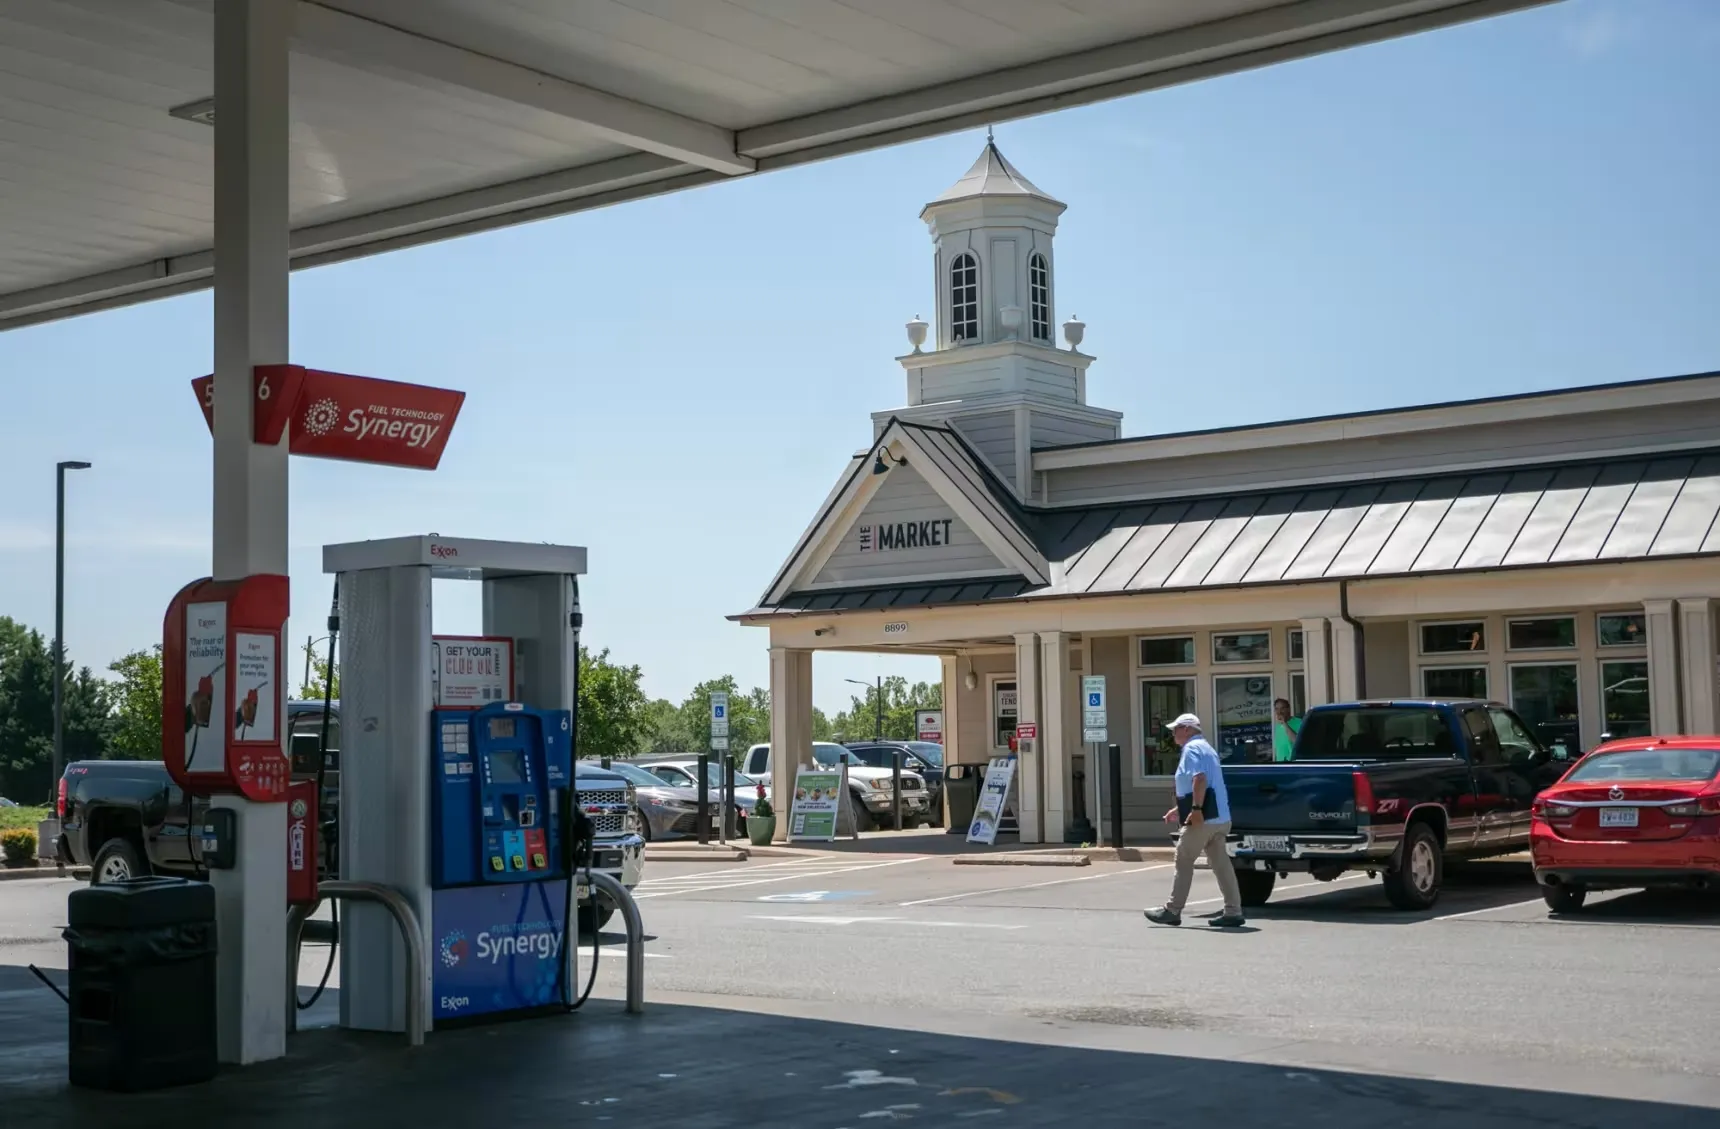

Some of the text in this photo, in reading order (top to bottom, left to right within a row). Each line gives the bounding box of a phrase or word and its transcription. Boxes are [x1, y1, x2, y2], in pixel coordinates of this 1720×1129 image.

[258, 376, 270, 400] 6
[368, 404, 444, 421] FUEL TECHNOLOGY
[344, 408, 440, 448] Synergy
[860, 526, 871, 551] THE
[879, 519, 952, 550] MARKET
[430, 544, 457, 559] Exxon
[884, 623, 907, 633] 8899
[189, 637, 202, 646] The
[216, 634, 224, 645] of
[189, 646, 224, 659] reliability
[446, 646, 491, 657] GET YOUR
[561, 717, 568, 731] 6
[1376, 798, 1400, 814] Z71
[294, 833, 302, 866] FIRE
[477, 931, 562, 964] Synergy
[441, 996, 469, 1011] Exxon
